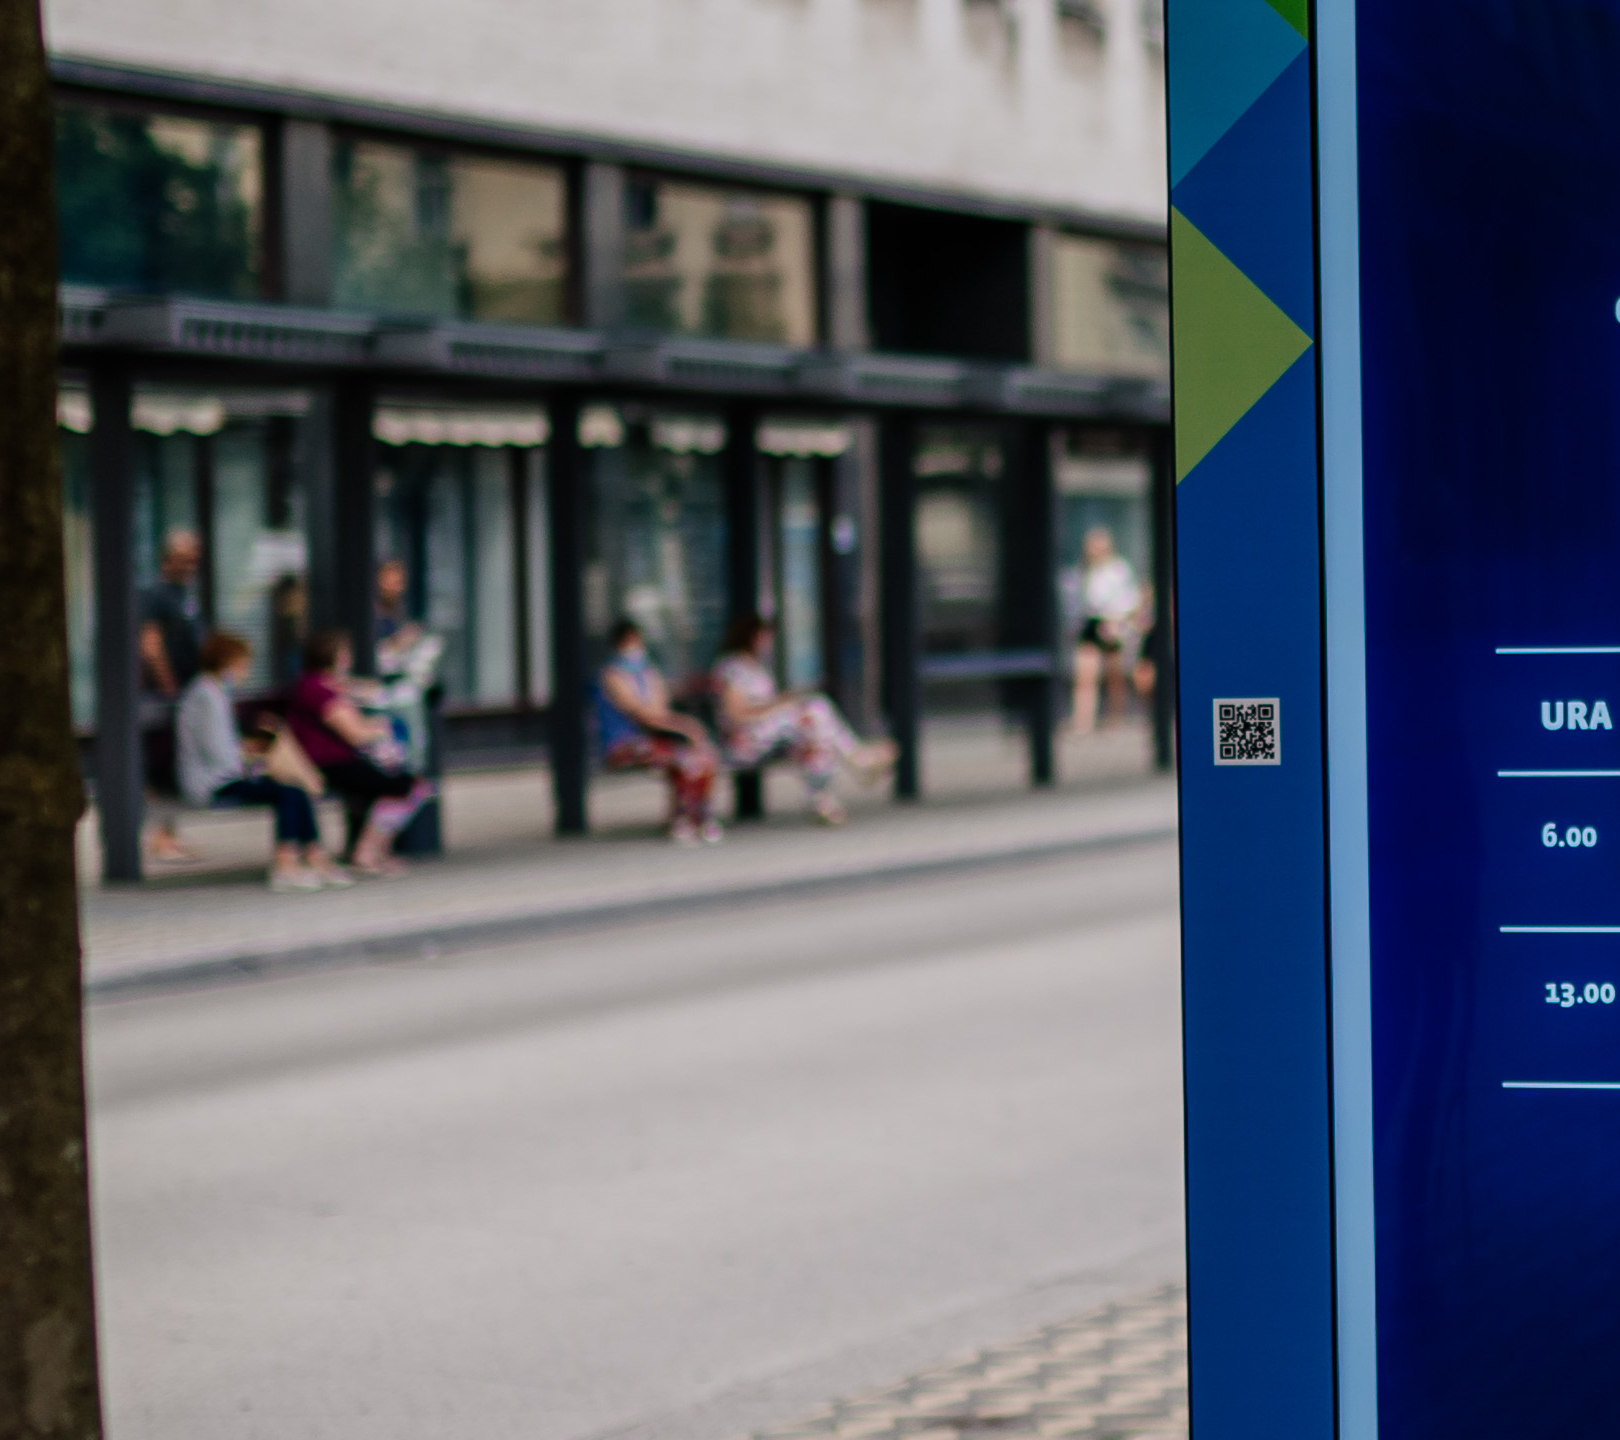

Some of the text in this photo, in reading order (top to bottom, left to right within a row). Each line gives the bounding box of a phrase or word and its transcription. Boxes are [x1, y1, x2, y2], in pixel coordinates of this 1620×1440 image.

[1540, 700, 1613, 731] URA
[1541, 822, 1598, 848] 6.00
[1544, 981, 1616, 1008] 13.00
